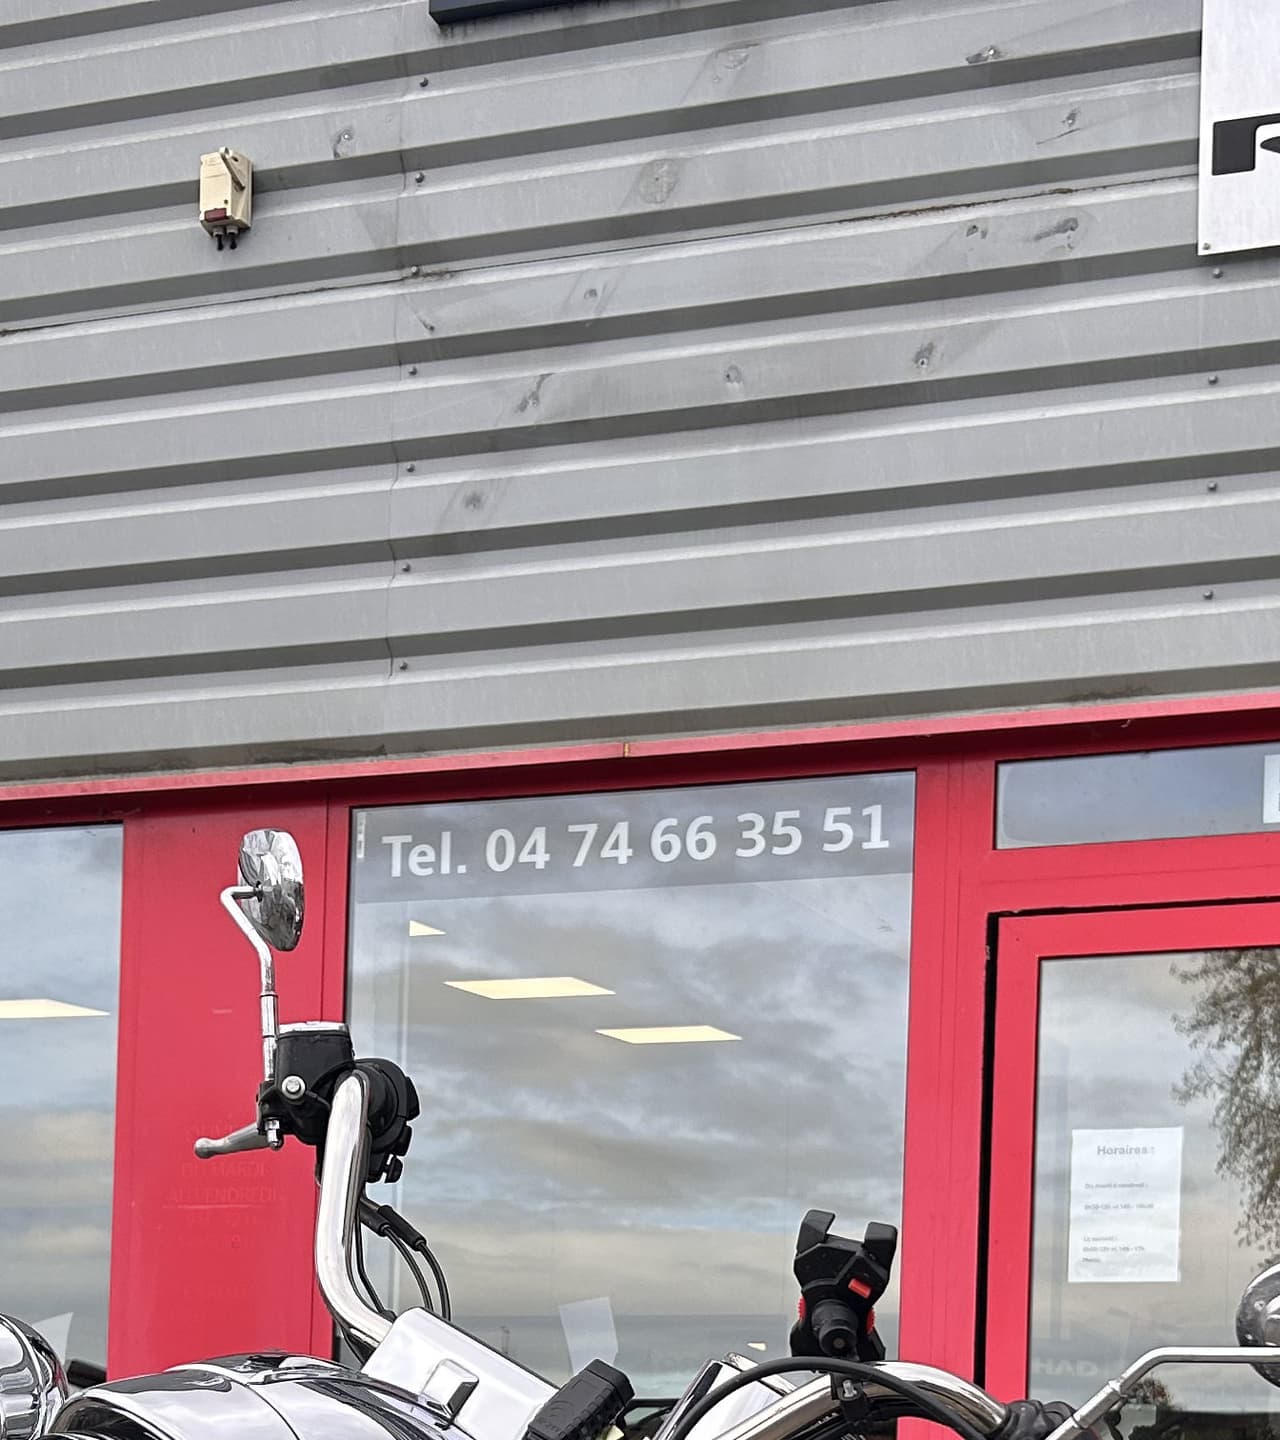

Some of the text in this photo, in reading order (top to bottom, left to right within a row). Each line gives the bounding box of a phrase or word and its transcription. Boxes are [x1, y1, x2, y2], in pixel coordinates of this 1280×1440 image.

[382, 830, 467, 878] Tel.
[485, 826, 551, 873] 04
[568, 820, 633, 868] 74
[649, 815, 717, 862] 66
[734, 809, 802, 858] 35
[821, 804, 890, 853] 51
